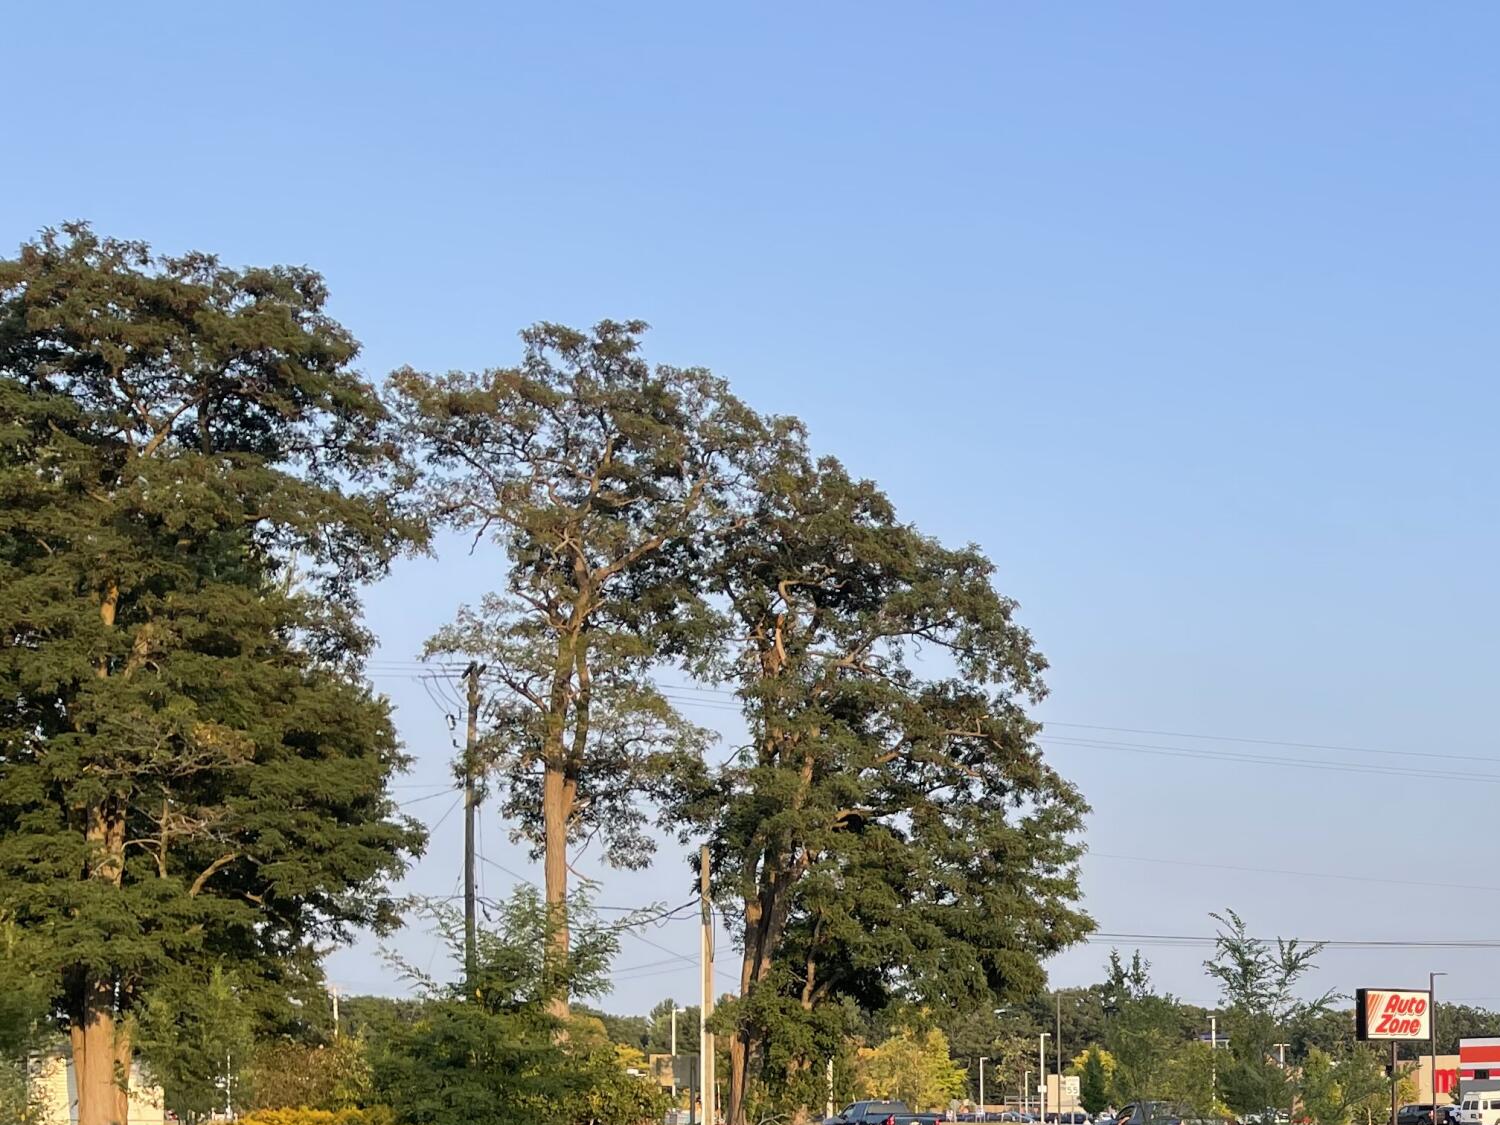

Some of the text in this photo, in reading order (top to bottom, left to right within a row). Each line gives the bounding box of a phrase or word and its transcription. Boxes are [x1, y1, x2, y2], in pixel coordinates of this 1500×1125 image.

[1384, 994, 1426, 1014] Auto
[1375, 1014, 1421, 1034] Zone
[1067, 1086, 1078, 1094] 55
